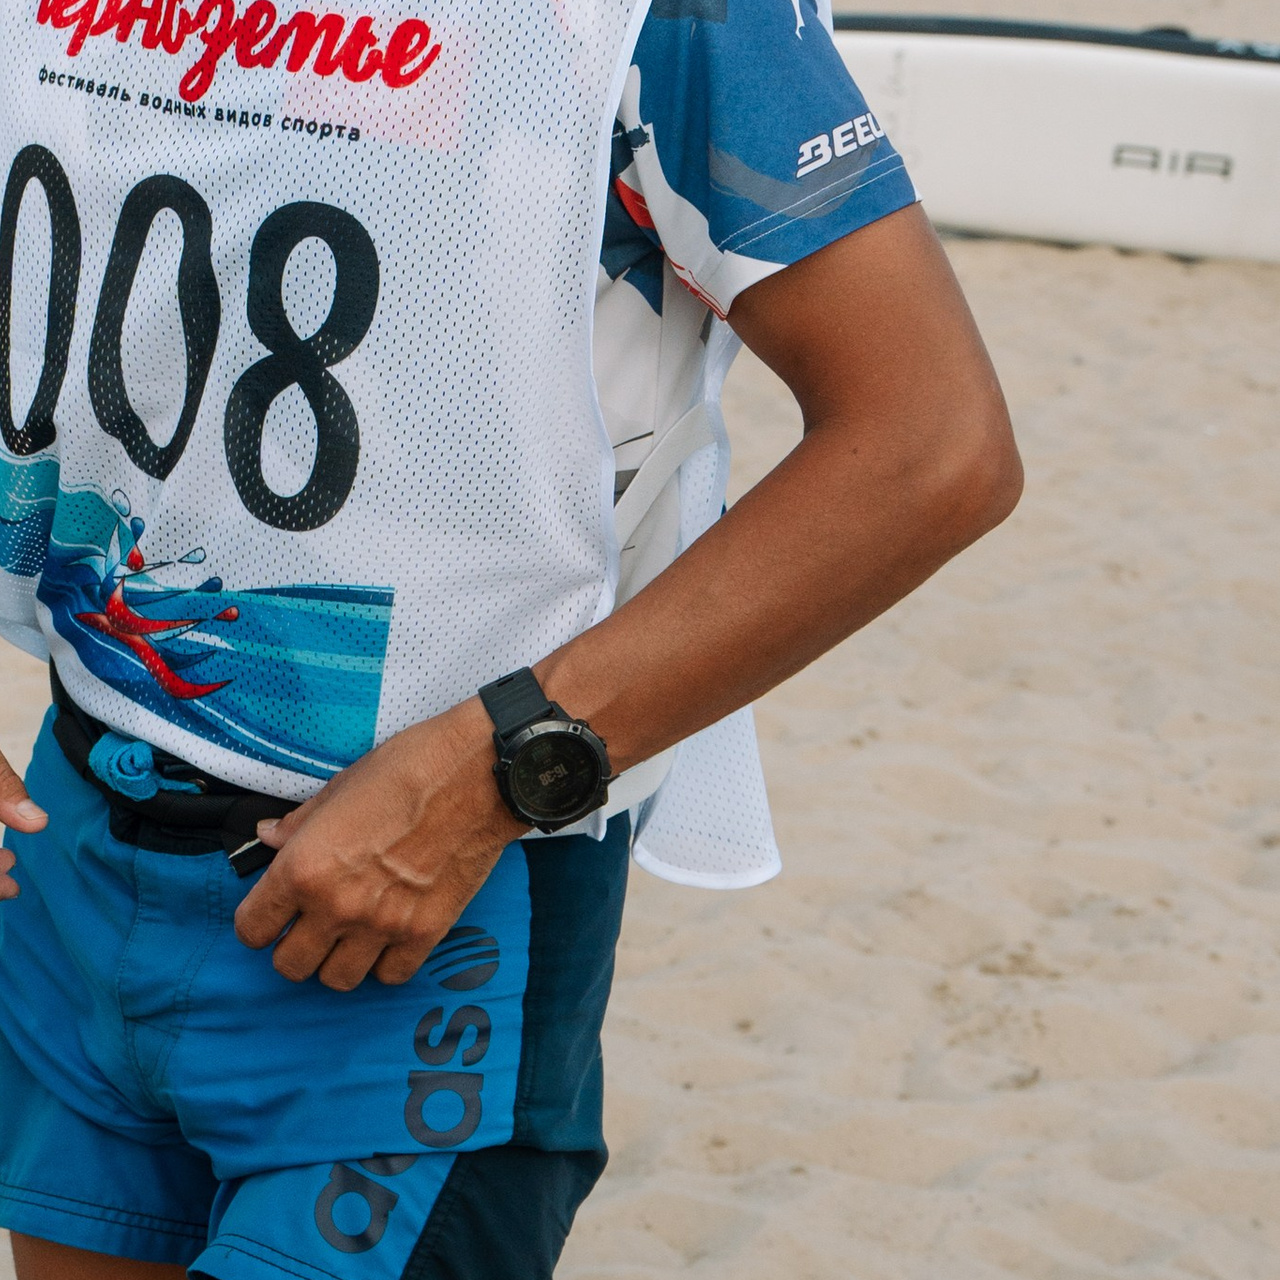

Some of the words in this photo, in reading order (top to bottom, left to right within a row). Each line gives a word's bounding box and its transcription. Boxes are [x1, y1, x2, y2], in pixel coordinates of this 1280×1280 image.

[38, 65, 130, 103] фестиваль
[139, 92, 207, 120] водных
[214, 106, 273, 128] видов
[280, 115, 362, 143] спорта
